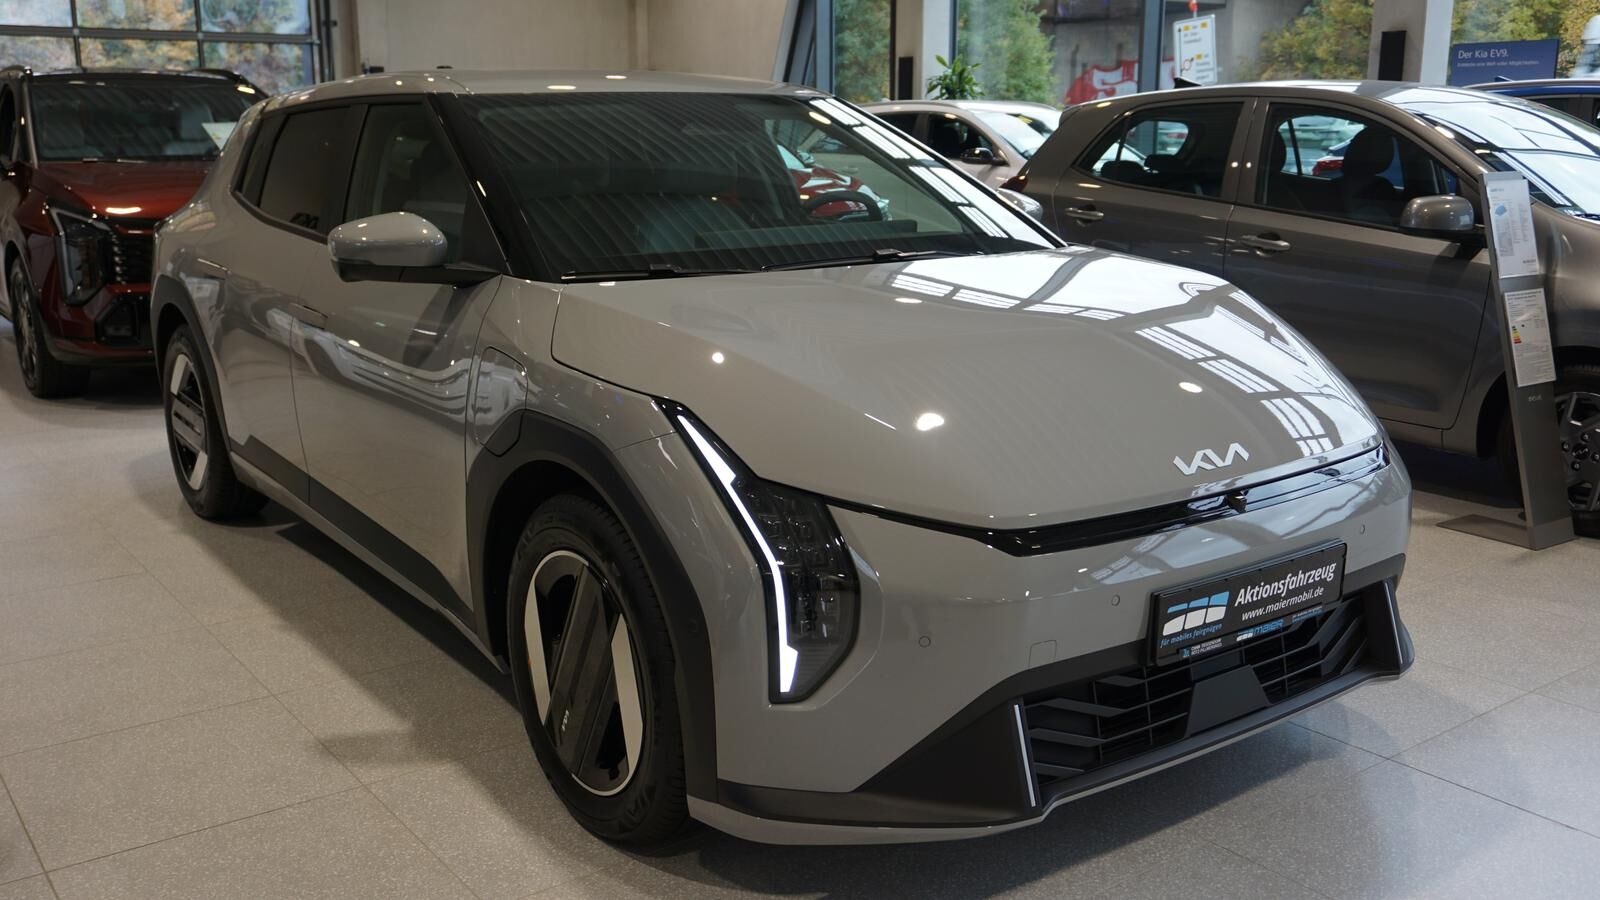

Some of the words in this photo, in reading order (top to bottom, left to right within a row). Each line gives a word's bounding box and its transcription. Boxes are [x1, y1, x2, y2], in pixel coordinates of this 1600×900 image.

[1458, 50, 1473, 59] Der
[1475, 50, 1488, 58] Kia
[1490, 48, 1509, 58] EV9.
[1173, 442, 1249, 476] KIA
[1234, 563, 1337, 607] Aktionsfahrzeug
[1241, 586, 1325, 621] www.maiermobil.de
